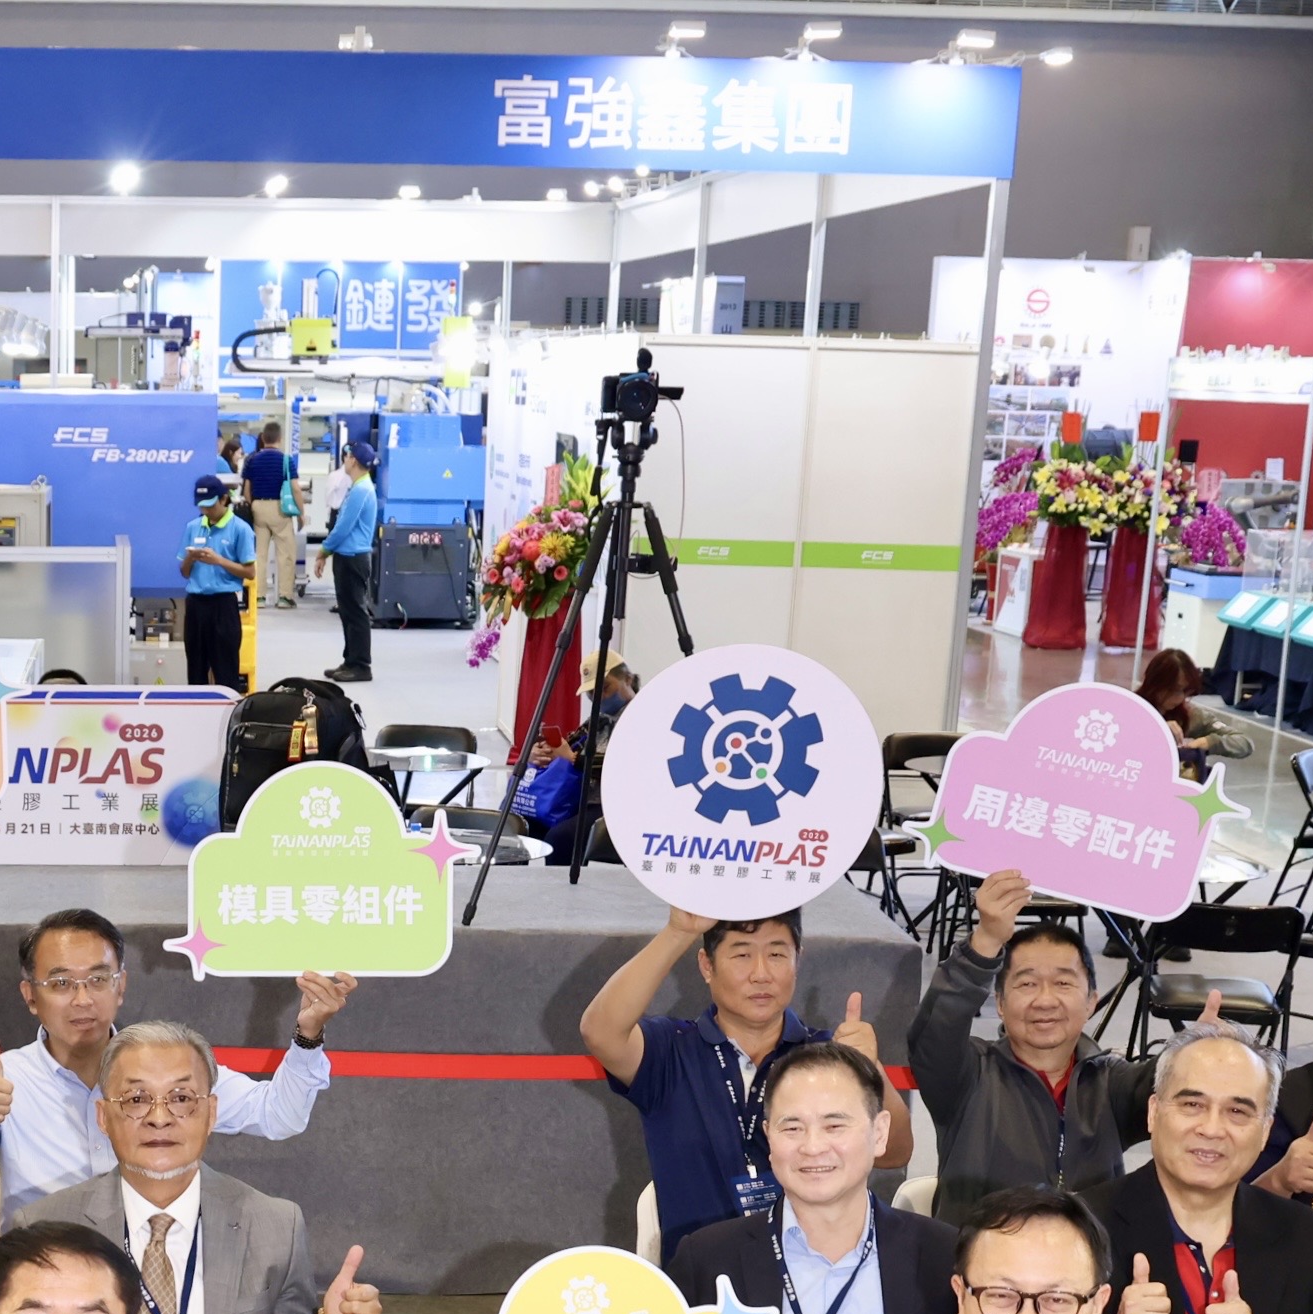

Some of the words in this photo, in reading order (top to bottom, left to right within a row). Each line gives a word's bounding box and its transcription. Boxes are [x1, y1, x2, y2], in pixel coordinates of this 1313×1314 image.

[493, 75, 854, 157] 富強鑫集團
[345, 279, 455, 333] 鏈發
[54, 427, 110, 444] FCS
[91, 447, 194, 465] FB-280RSV
[697, 546, 731, 557] FCS
[861, 550, 895, 561] FCS
[124, 726, 159, 741] 2026
[69, 822, 161, 837] 大臺南會展中心
[962, 782, 1176, 871] 周邊零配件
[800, 830, 827, 842] 2026
[641, 858, 822, 885] 臺南橡塑膠工業展
[217, 884, 424, 928] 模具零組件
